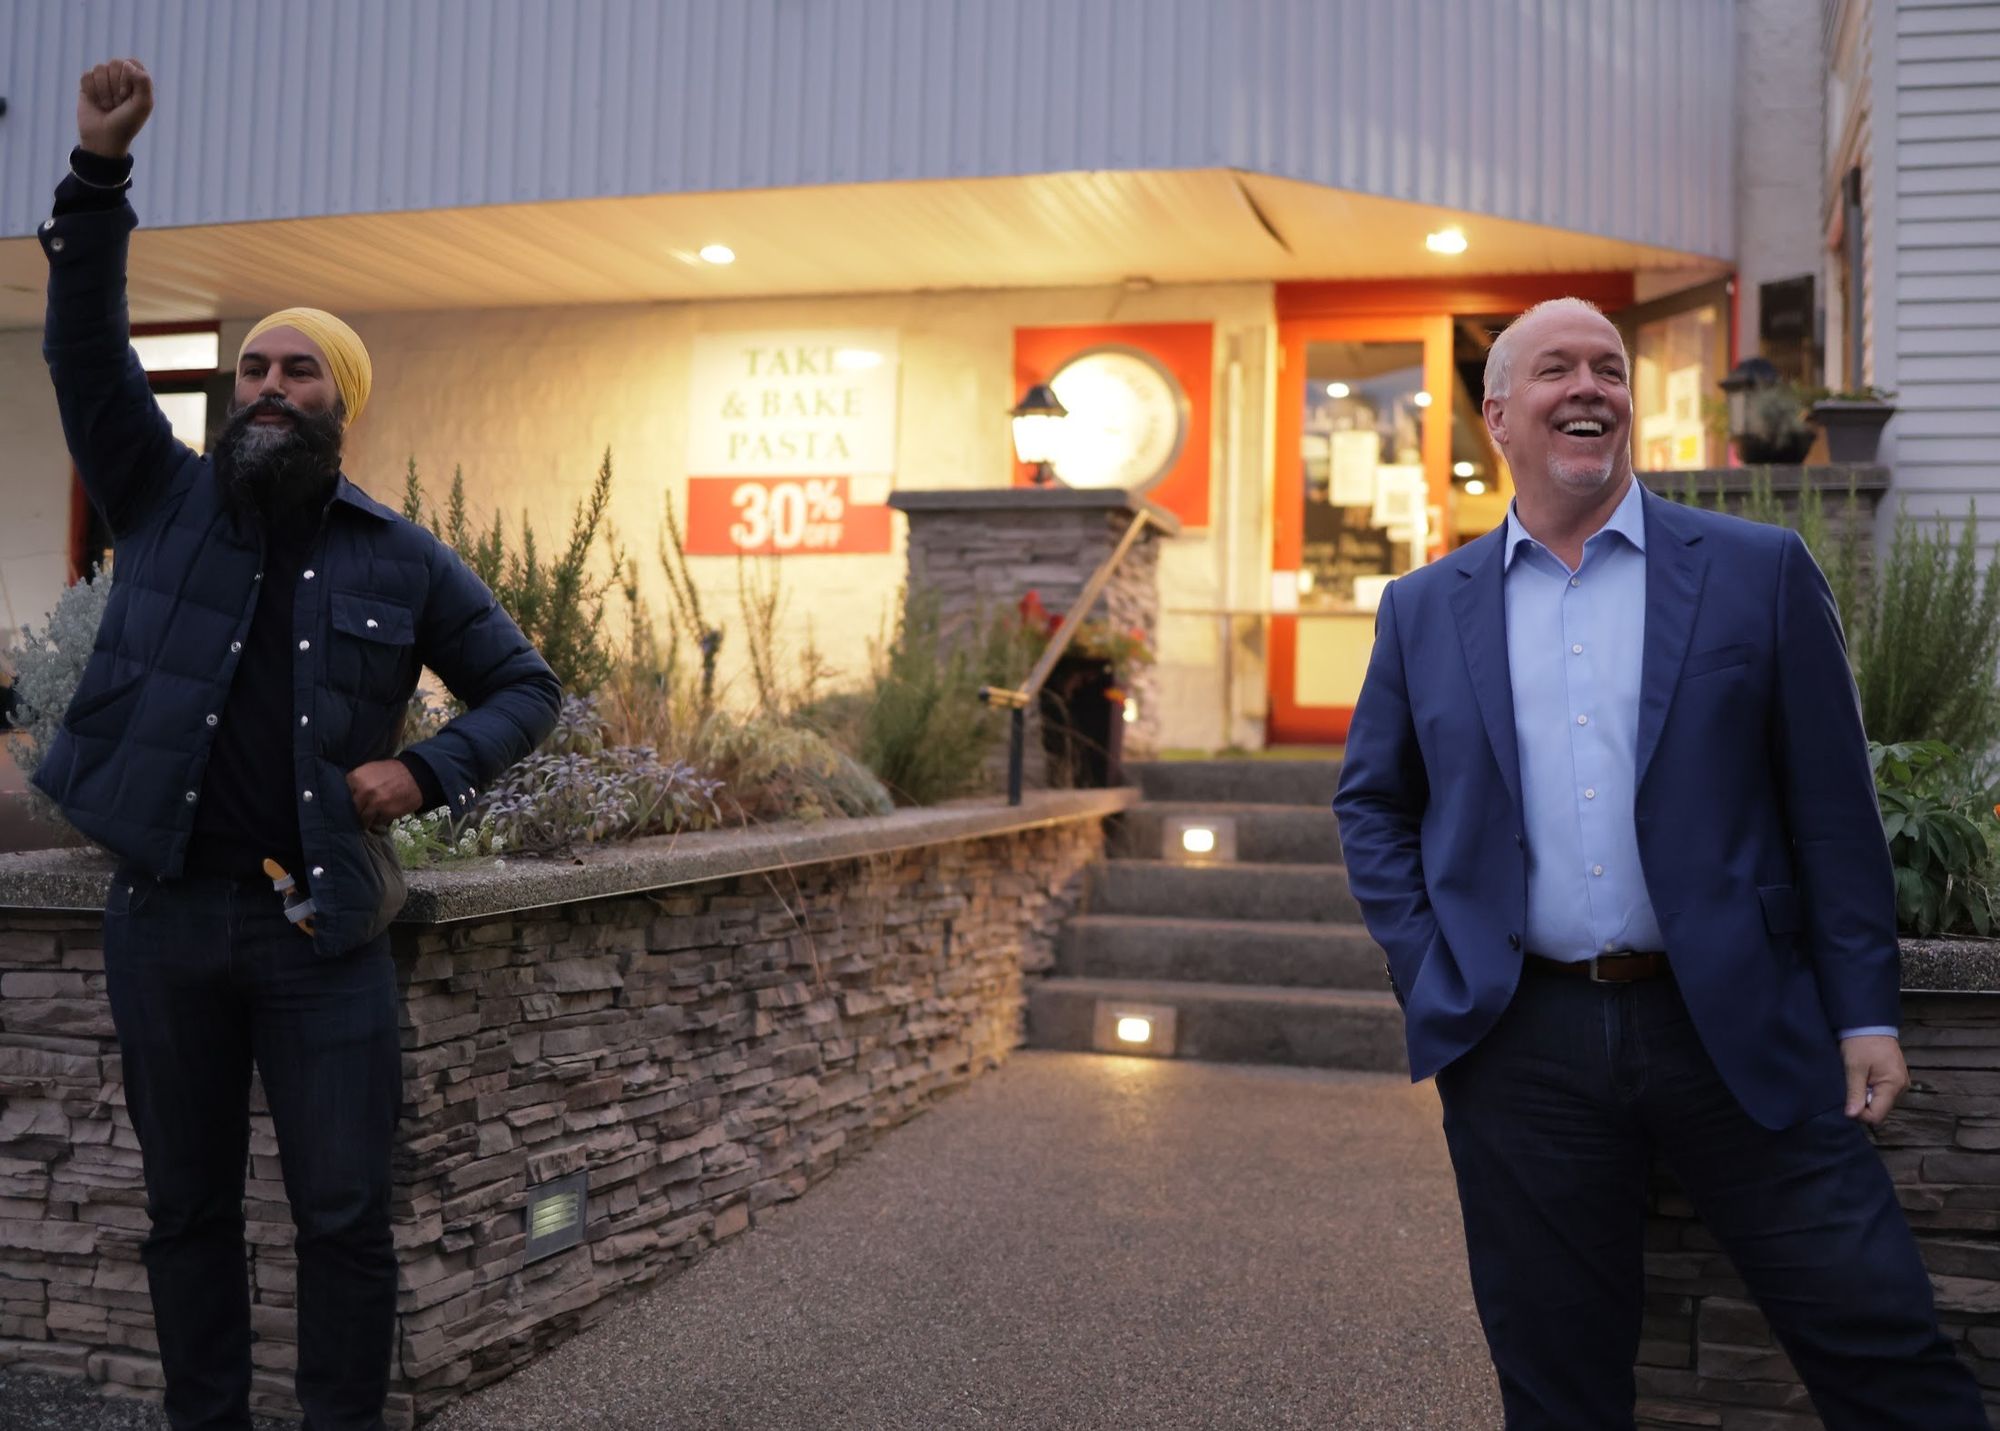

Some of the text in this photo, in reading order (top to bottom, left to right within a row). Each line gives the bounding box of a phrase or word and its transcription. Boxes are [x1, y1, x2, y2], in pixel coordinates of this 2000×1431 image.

[720, 385, 863, 420] & BAKE
[728, 430, 853, 462] PASTA
[729, 479, 845, 550] 30%
